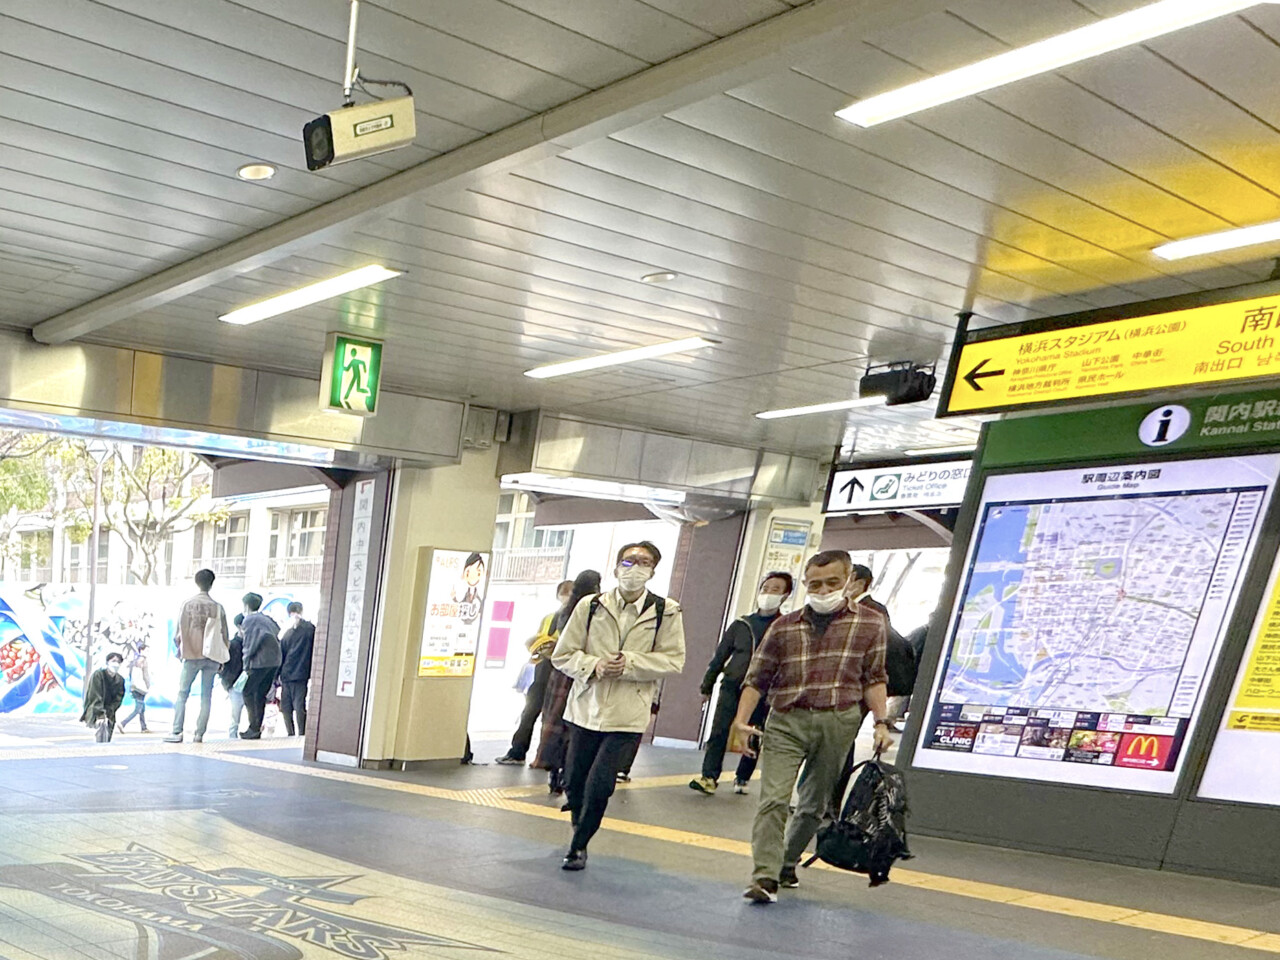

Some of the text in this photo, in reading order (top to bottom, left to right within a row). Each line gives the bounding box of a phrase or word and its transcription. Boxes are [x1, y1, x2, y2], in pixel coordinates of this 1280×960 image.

[1240, 306, 1280, 333] 南
[1216, 334, 1274, 355] South
[1016, 347, 1101, 365] Yokohama Stadium
[1081, 354, 1120, 368] 山下公園
[1193, 357, 1244, 375] 南出口
[1204, 400, 1280, 424] 関内駅
[1200, 422, 1249, 436] Kannai
[925, 482, 948, 490] Office
[940, 736, 972, 745] CLINIC
[259, 876, 312, 895] DeNA
[50, 882, 205, 933] YOKOHAMA
